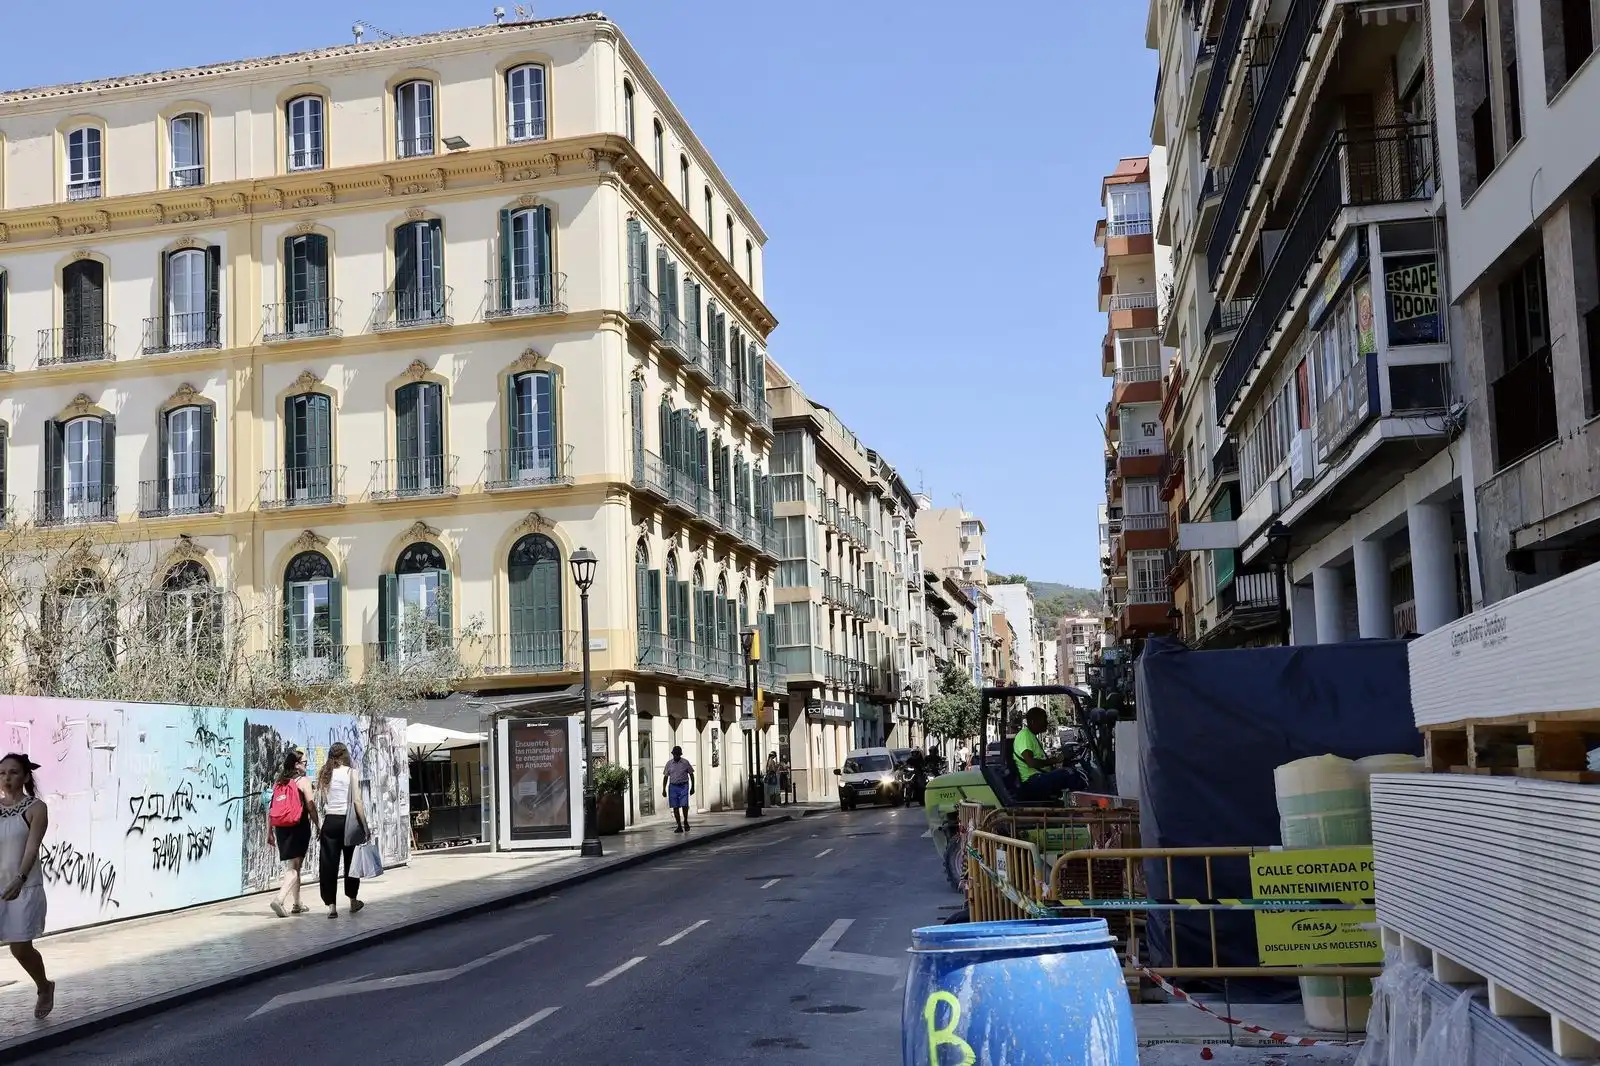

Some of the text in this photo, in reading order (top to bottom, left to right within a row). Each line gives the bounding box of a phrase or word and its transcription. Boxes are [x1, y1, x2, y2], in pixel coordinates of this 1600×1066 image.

[1386, 263, 1437, 294] ESCAPE
[1393, 295, 1438, 321] ROOM
[1257, 861, 1375, 876] CALLE CORTADA PO
[1259, 880, 1369, 895] MANTENIMIENTO
[1297, 922, 1332, 931] EMASA
[1264, 940, 1377, 952] DISCULPEN LAS MOLESTIAS
[925, 991, 976, 1066] B
